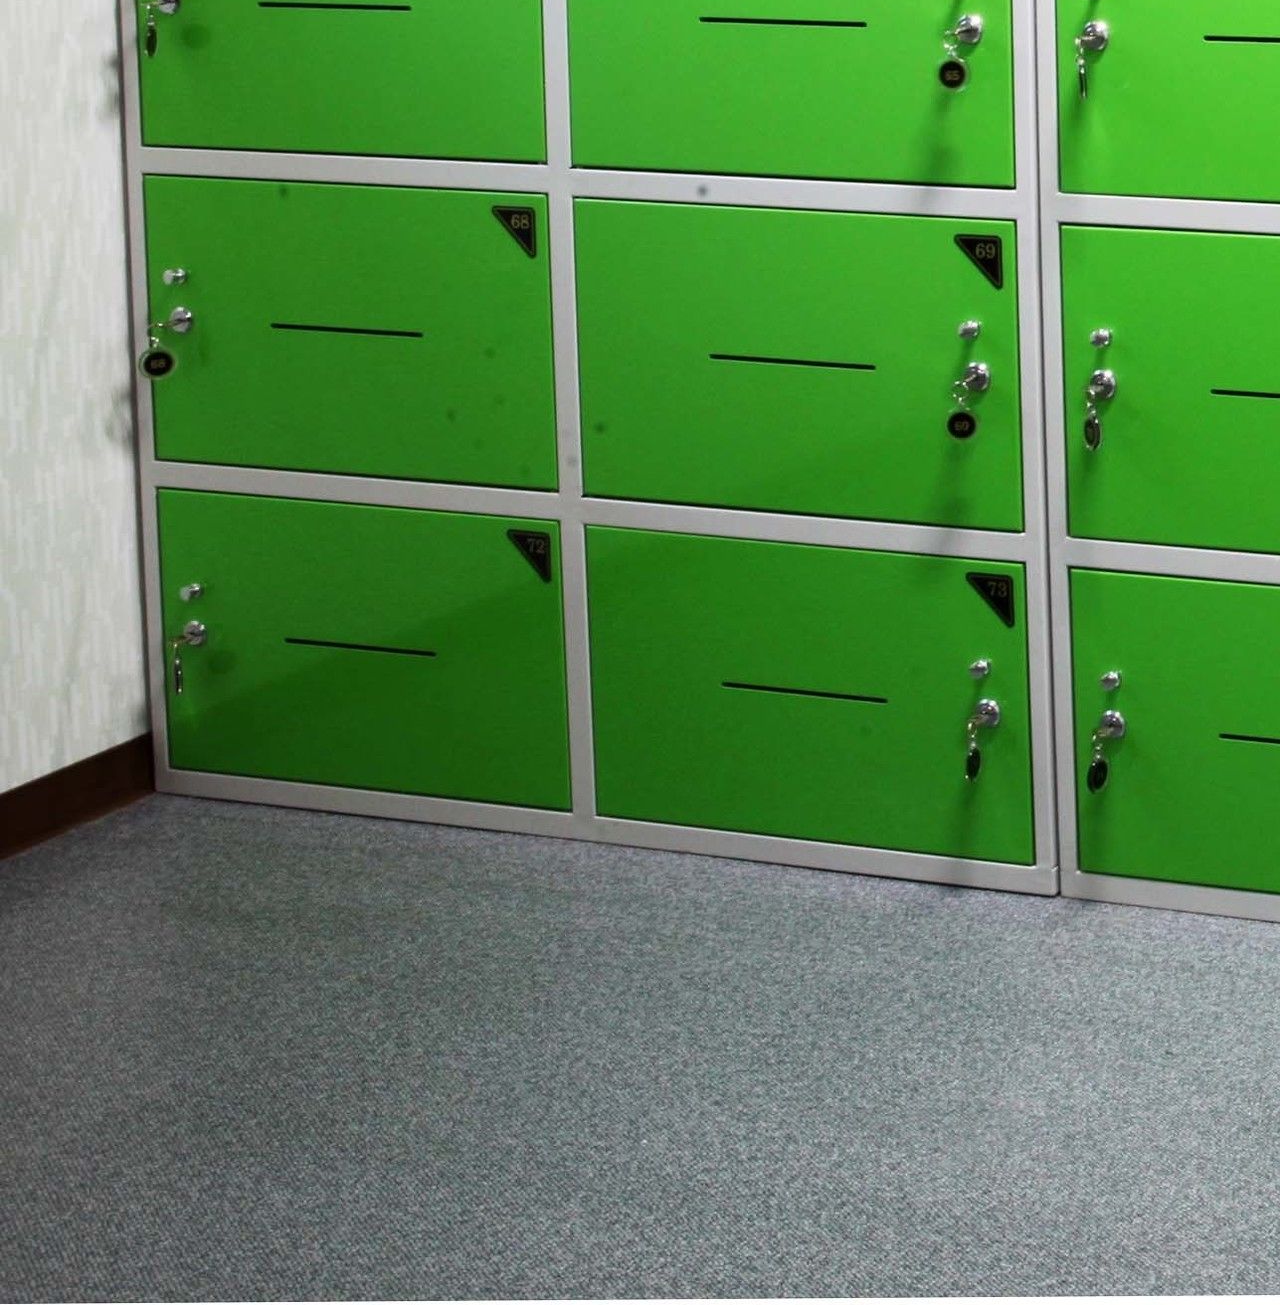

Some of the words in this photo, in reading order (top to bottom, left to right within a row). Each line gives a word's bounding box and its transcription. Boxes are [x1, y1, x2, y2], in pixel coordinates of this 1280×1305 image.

[510, 213, 529, 230] 68
[974, 242, 995, 259] 69
[525, 537, 545, 554] 72
[986, 580, 1008, 597] 73
